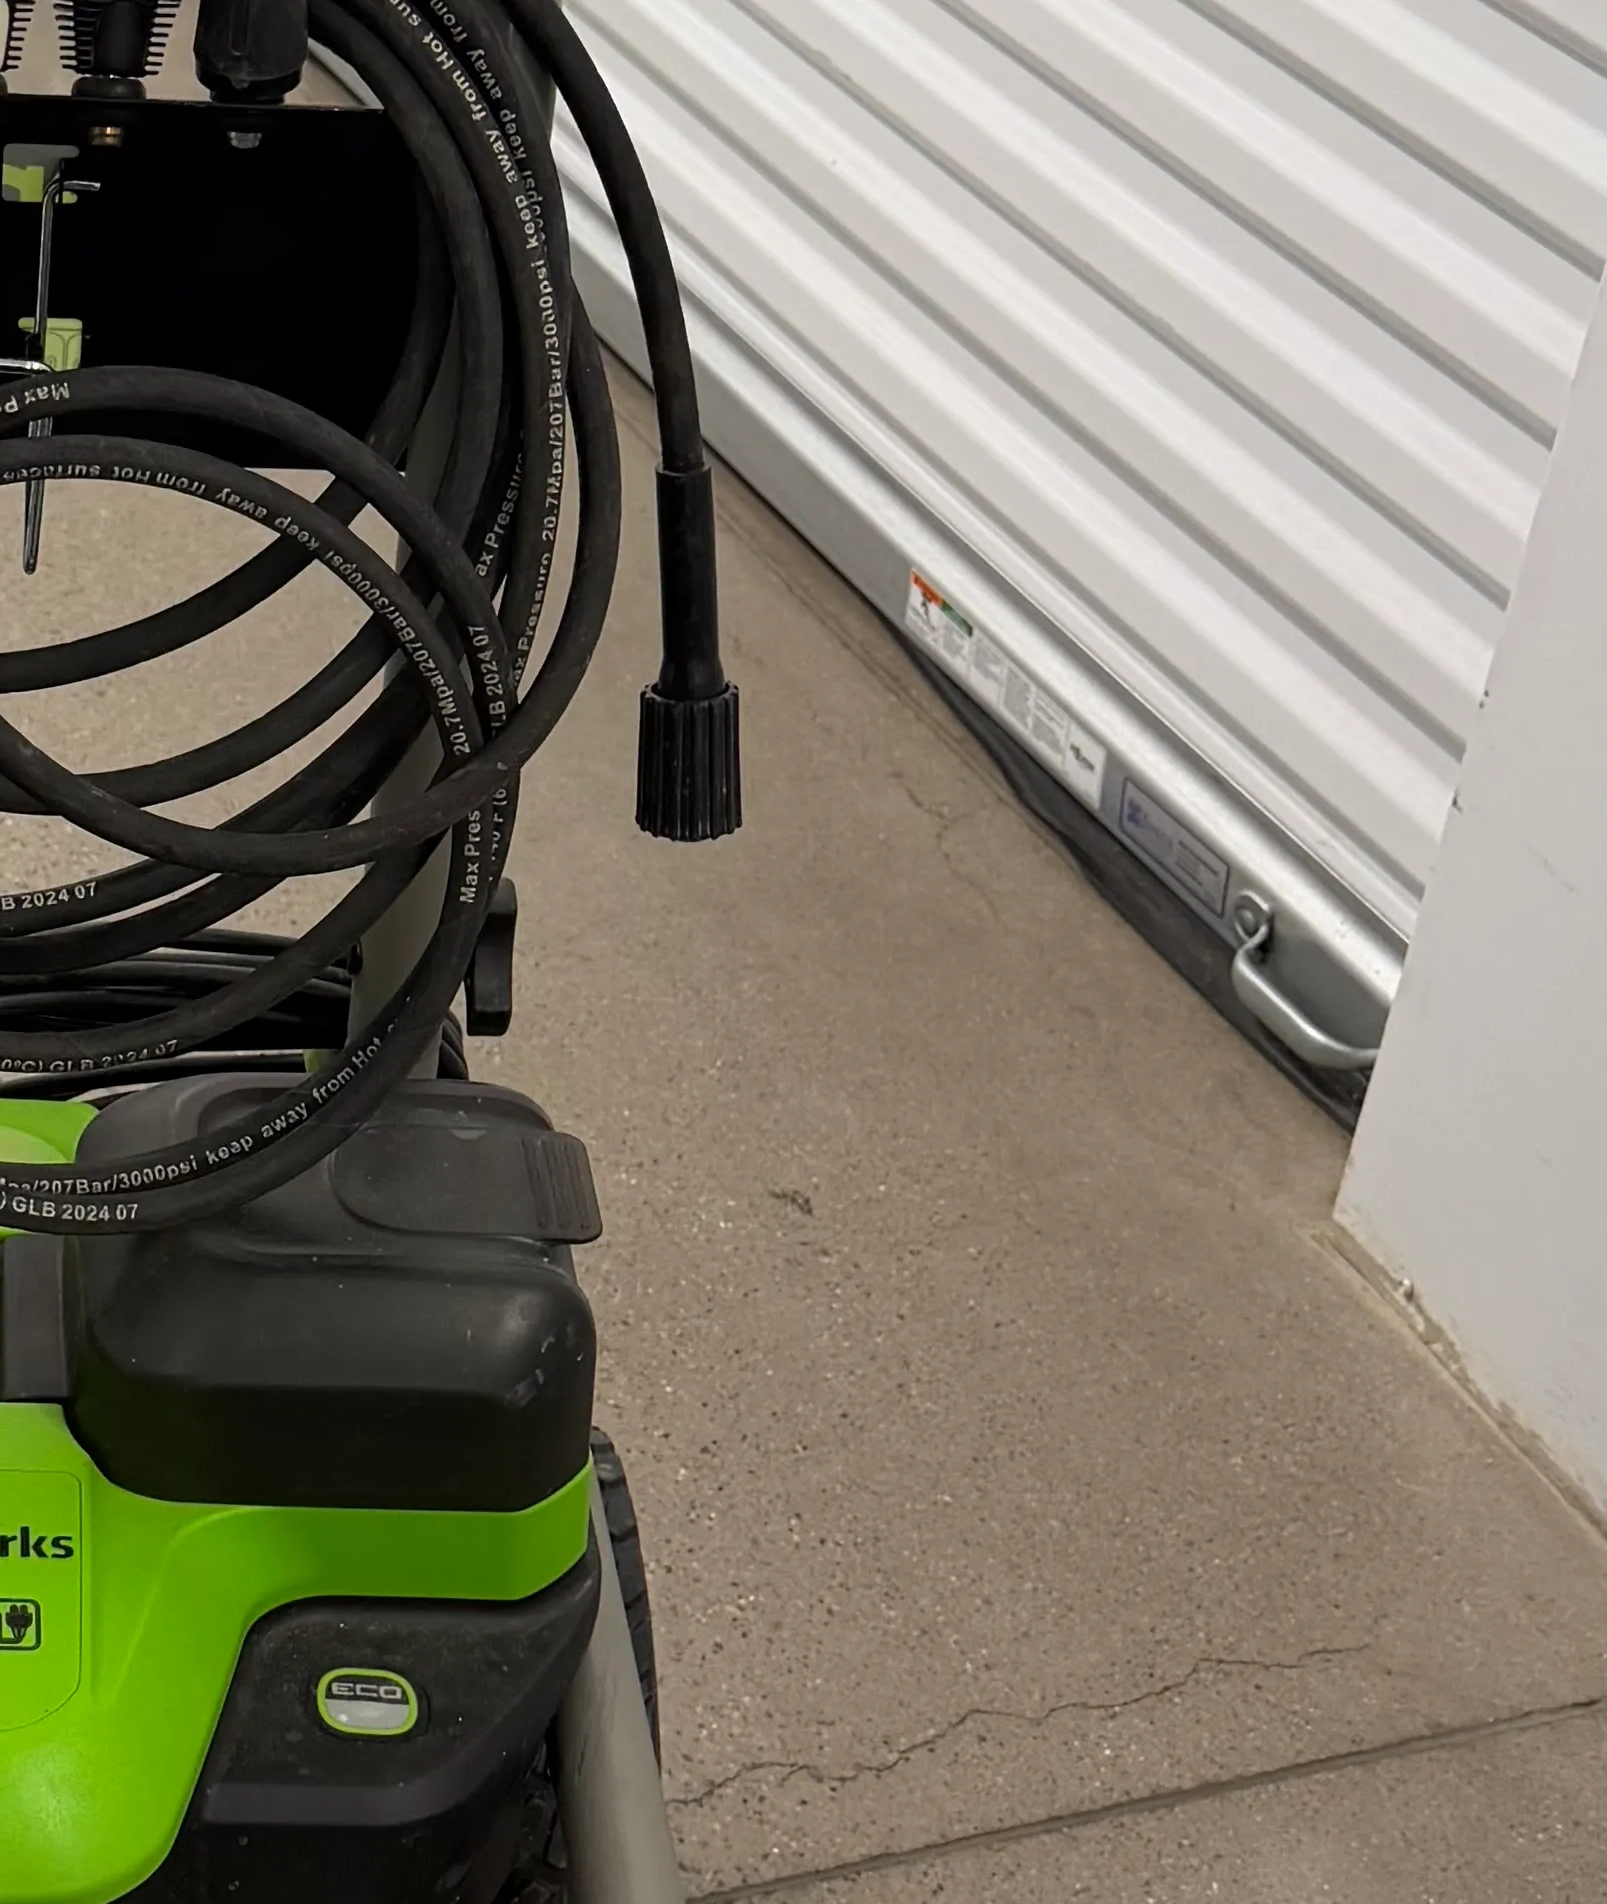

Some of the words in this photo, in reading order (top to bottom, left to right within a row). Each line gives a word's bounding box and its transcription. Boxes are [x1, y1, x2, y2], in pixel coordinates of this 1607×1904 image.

[422, 31, 454, 70] Hot
[466, 48, 503, 100] away
[452, 69, 488, 122] from
[499, 108, 527, 159] keep
[485, 129, 518, 184] away
[514, 193, 539, 250] keep
[25, 382, 71, 404] Max
[216, 487, 267, 519] away
[274, 515, 321, 551] keep
[475, 551, 494, 577] ax
[324, 550, 471, 756] 20.7Mpa/207Bar/3000psi
[468, 626, 490, 647] 07
[480, 650, 507, 697] 2024
[489, 699, 507, 729] LB
[463, 809, 483, 856] Pres
[22, 888, 70, 909] 2024
[75, 882, 98, 899] 07
[460, 862, 481, 904] Max
[154, 1038, 179, 1058] 07
[261, 1102, 308, 1138] away
[312, 1066, 355, 1104] from
[352, 1037, 382, 1070] Hot
[11, 1196, 56, 1218] GLB
[61, 1203, 110, 1222] 2024
[116, 1203, 139, 1221] 07
[331, 1682, 403, 1700] ECO
